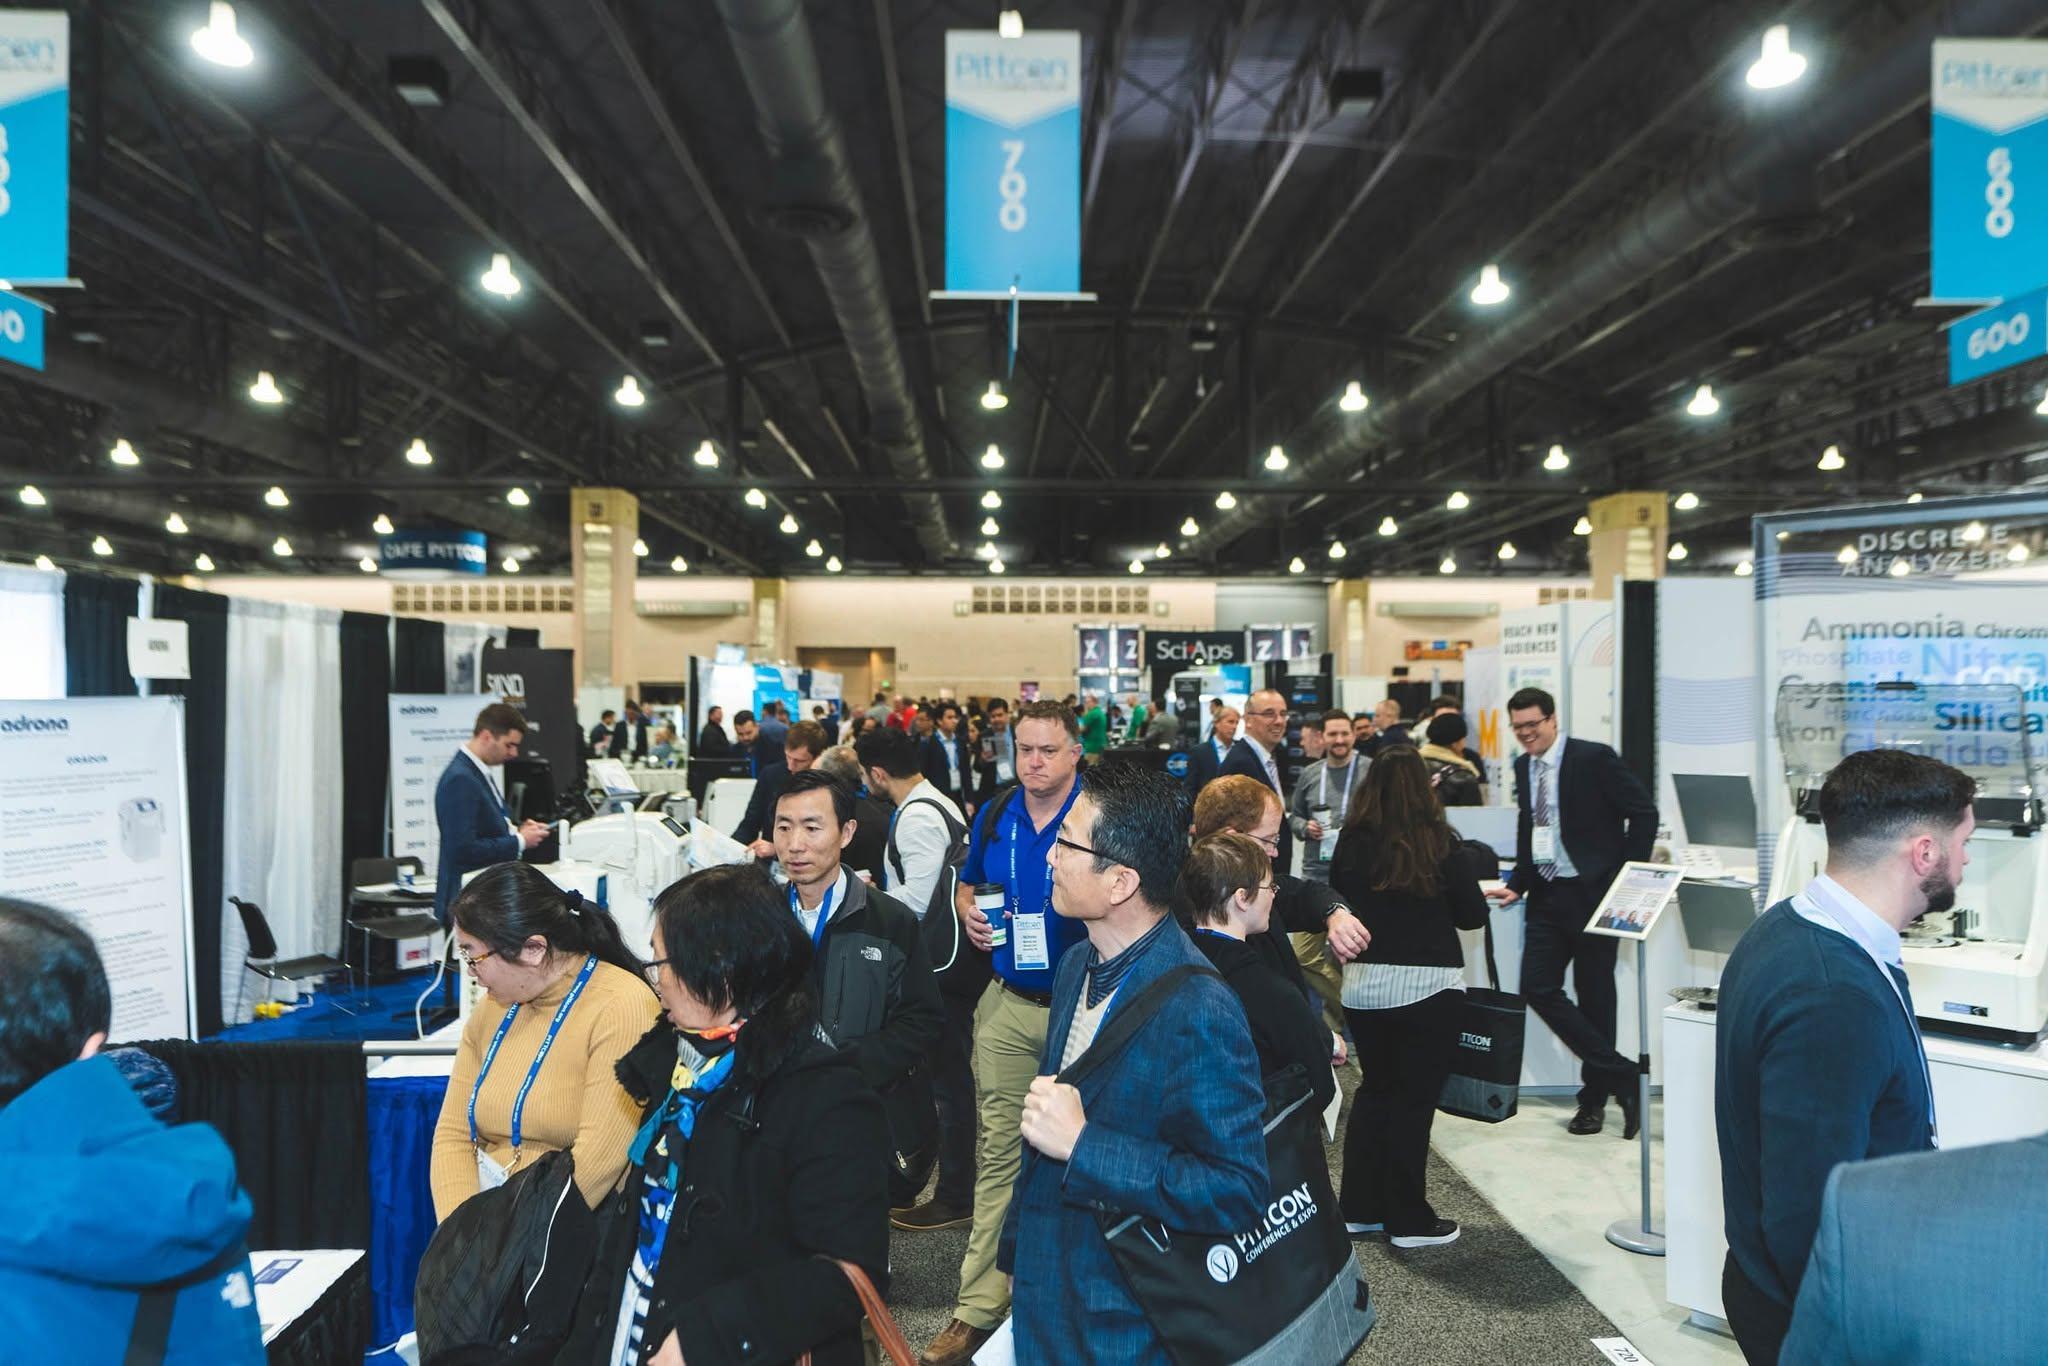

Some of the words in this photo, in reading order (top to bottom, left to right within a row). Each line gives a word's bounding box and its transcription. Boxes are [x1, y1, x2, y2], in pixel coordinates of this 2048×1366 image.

[955, 51, 1068, 81] Pittcon
[1000, 140, 1027, 231] 700
[1985, 148, 2014, 238] 600
[1967, 312, 2030, 360] 600
[1857, 523, 2008, 553] DISCREE
[1801, 613, 1965, 641] Ammonia
[1156, 639, 1233, 664] SciAps
[0, 714, 69, 731] adrona
[1245, 1225, 1292, 1264] CONFERENCE
[1298, 1203, 1318, 1225] EXPO
